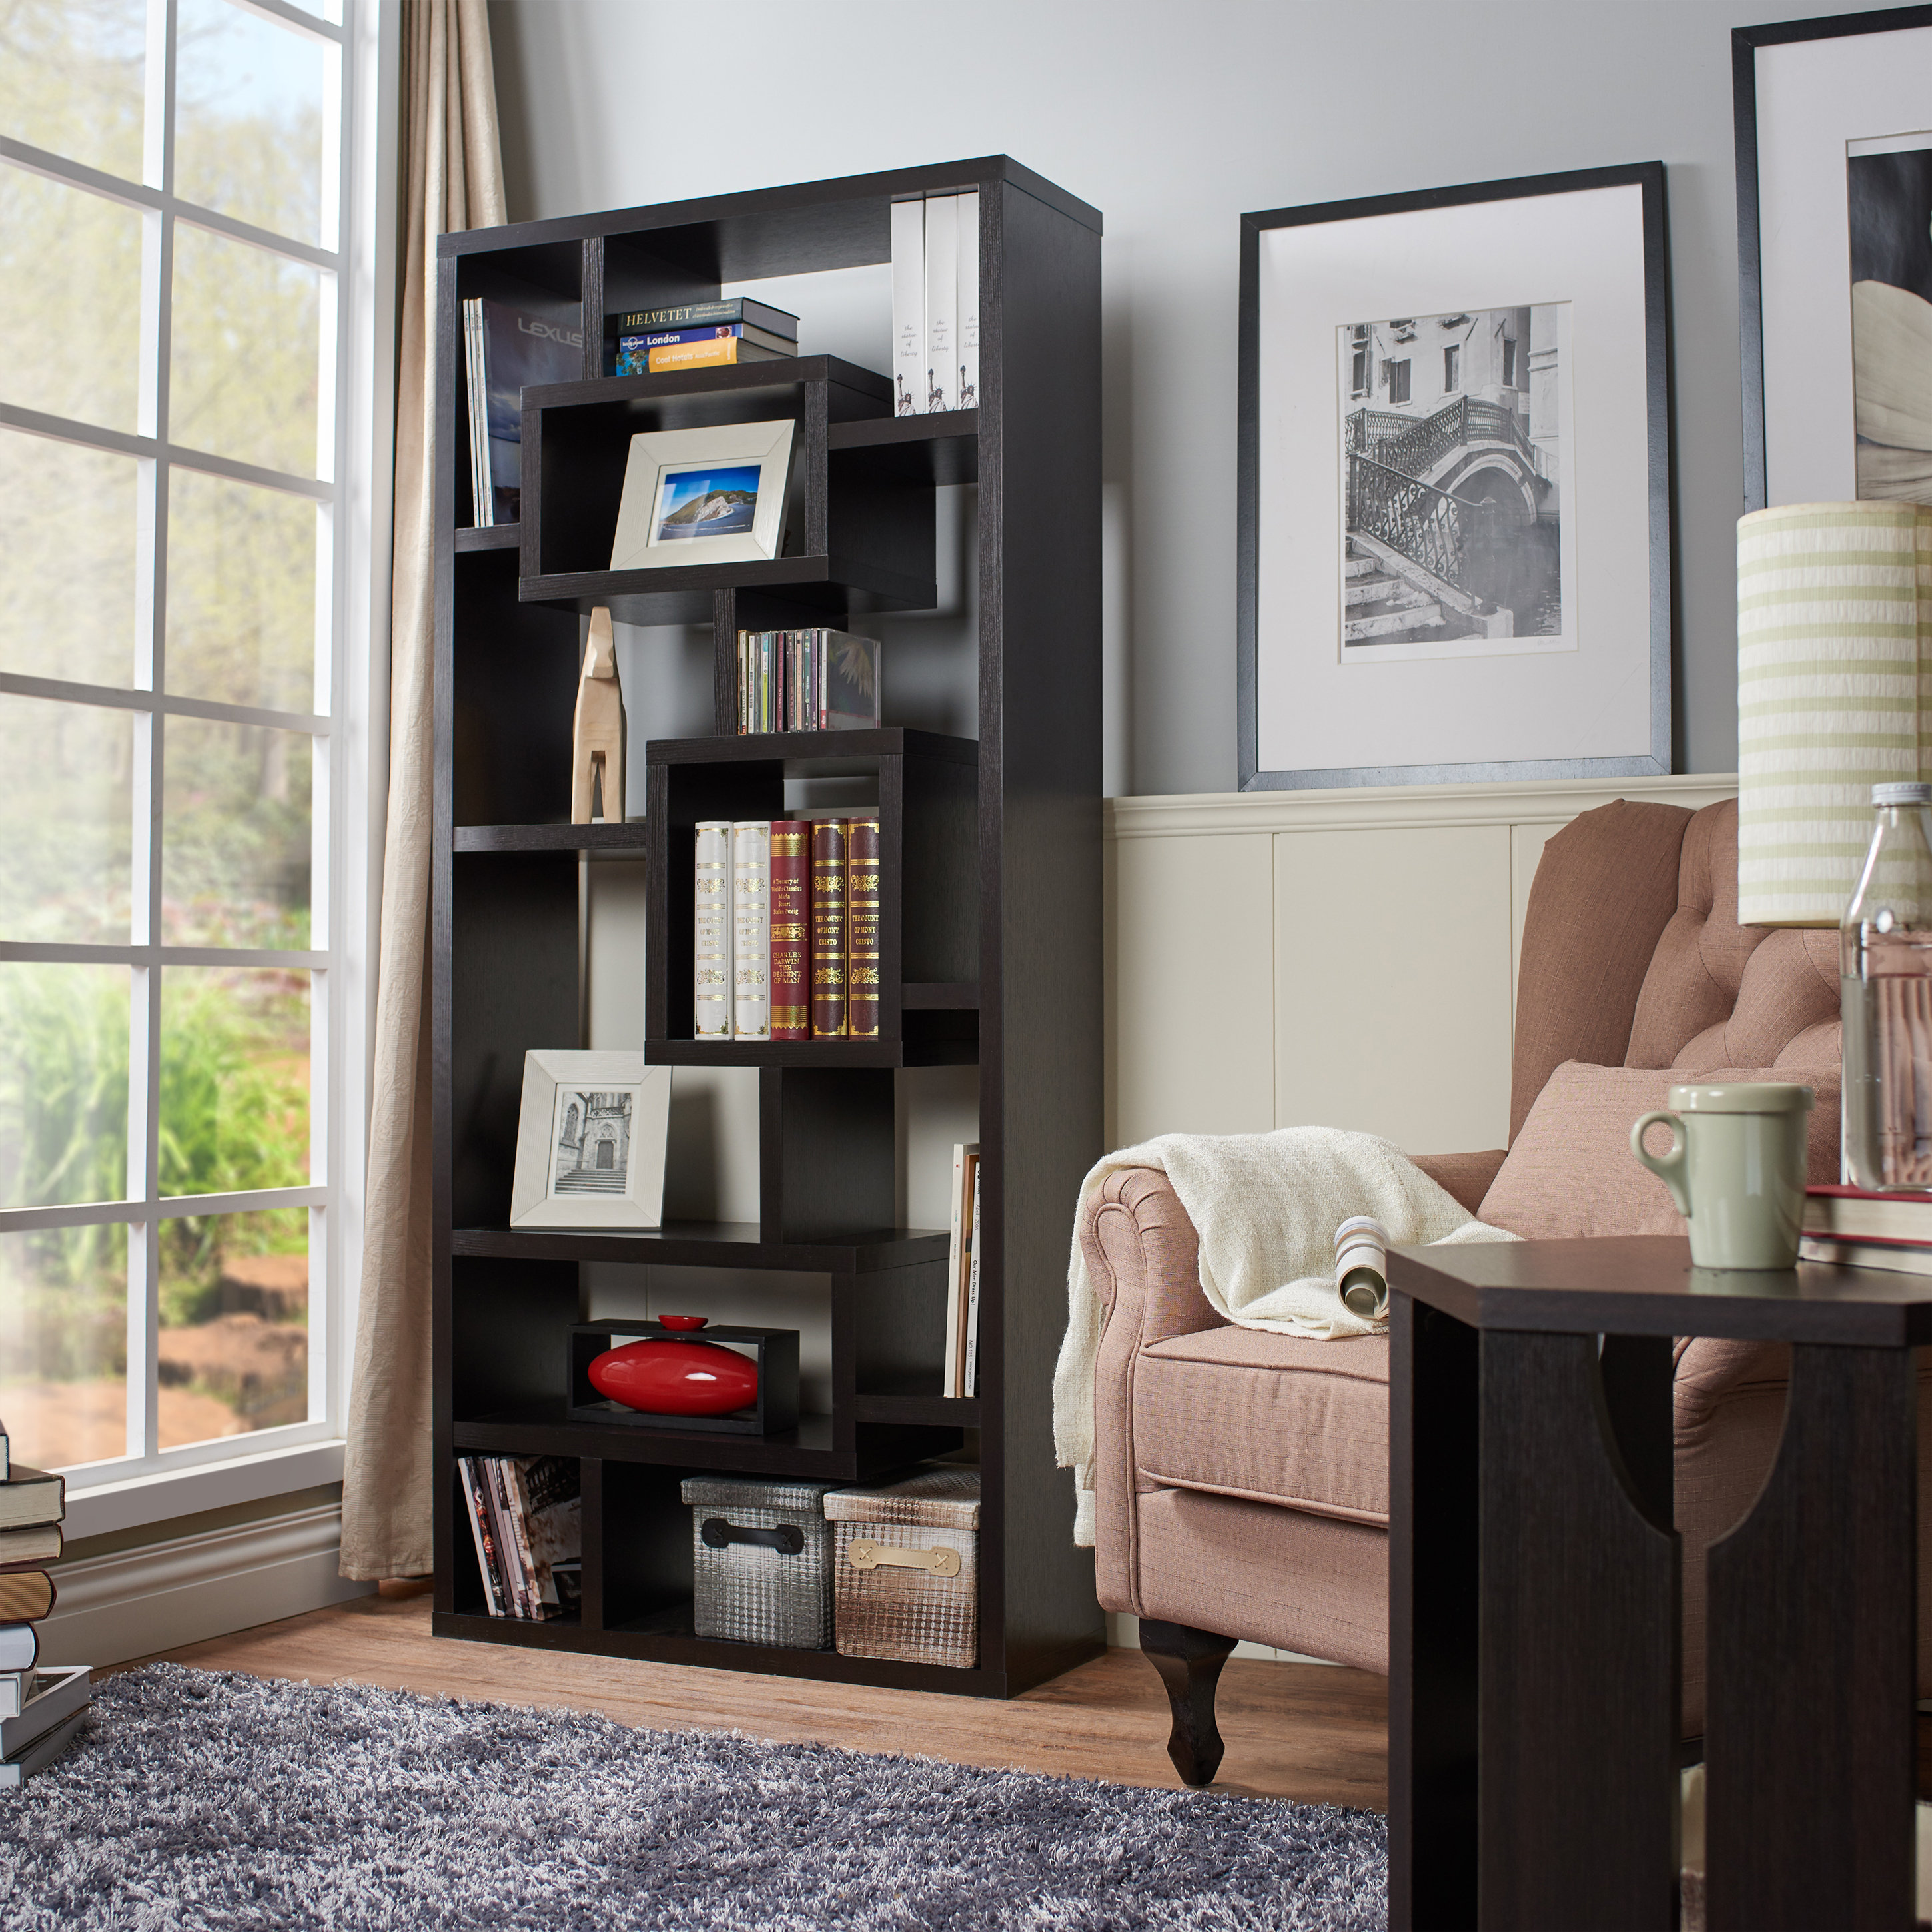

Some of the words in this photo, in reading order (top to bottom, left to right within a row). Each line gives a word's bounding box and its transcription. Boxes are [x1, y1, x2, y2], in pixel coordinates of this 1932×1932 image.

[626, 308, 692, 326] HELVETET
[518, 317, 582, 348] LEXUS
[647, 334, 680, 346] London
[656, 356, 670, 364] Cool
[672, 353, 694, 362] Hotels
